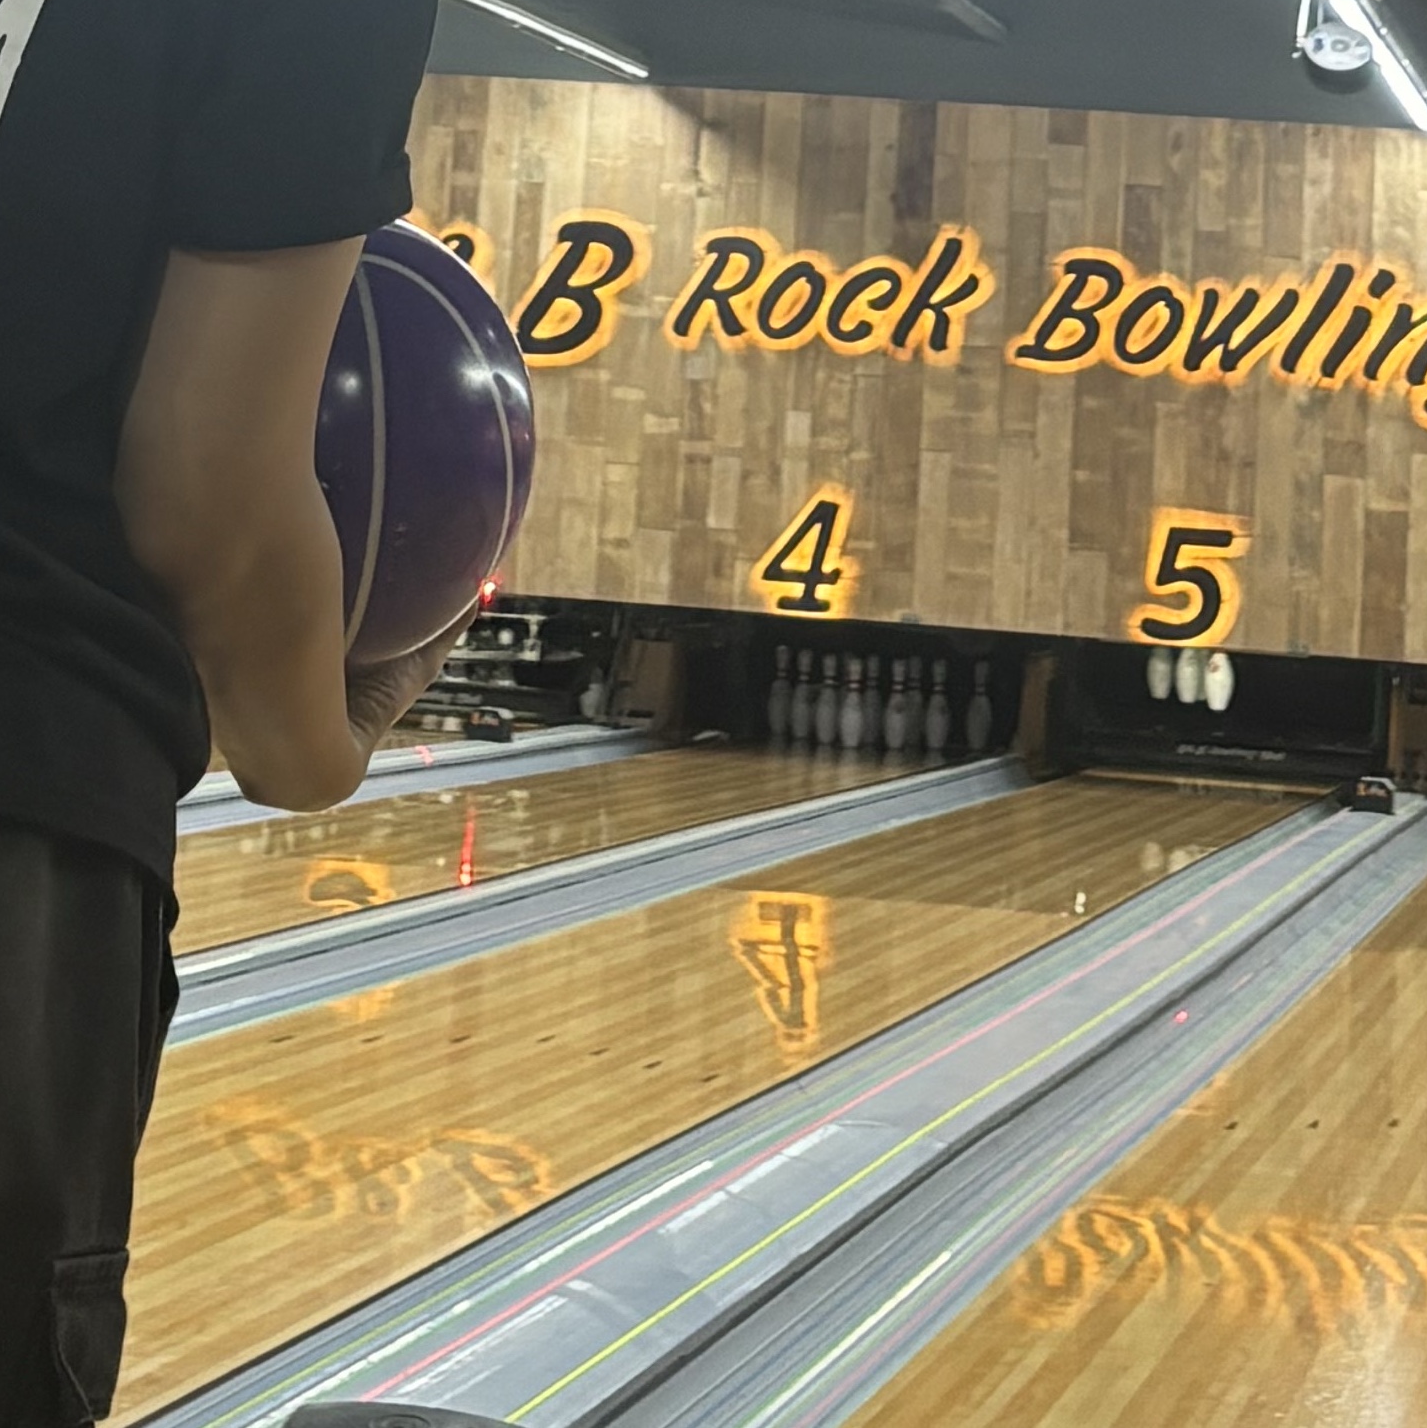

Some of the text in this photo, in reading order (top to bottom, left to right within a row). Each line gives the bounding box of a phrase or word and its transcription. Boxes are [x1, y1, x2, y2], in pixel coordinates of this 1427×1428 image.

[672, 225, 982, 357] Rock
[763, 501, 846, 611] 4
[1142, 527, 1234, 641] 5
